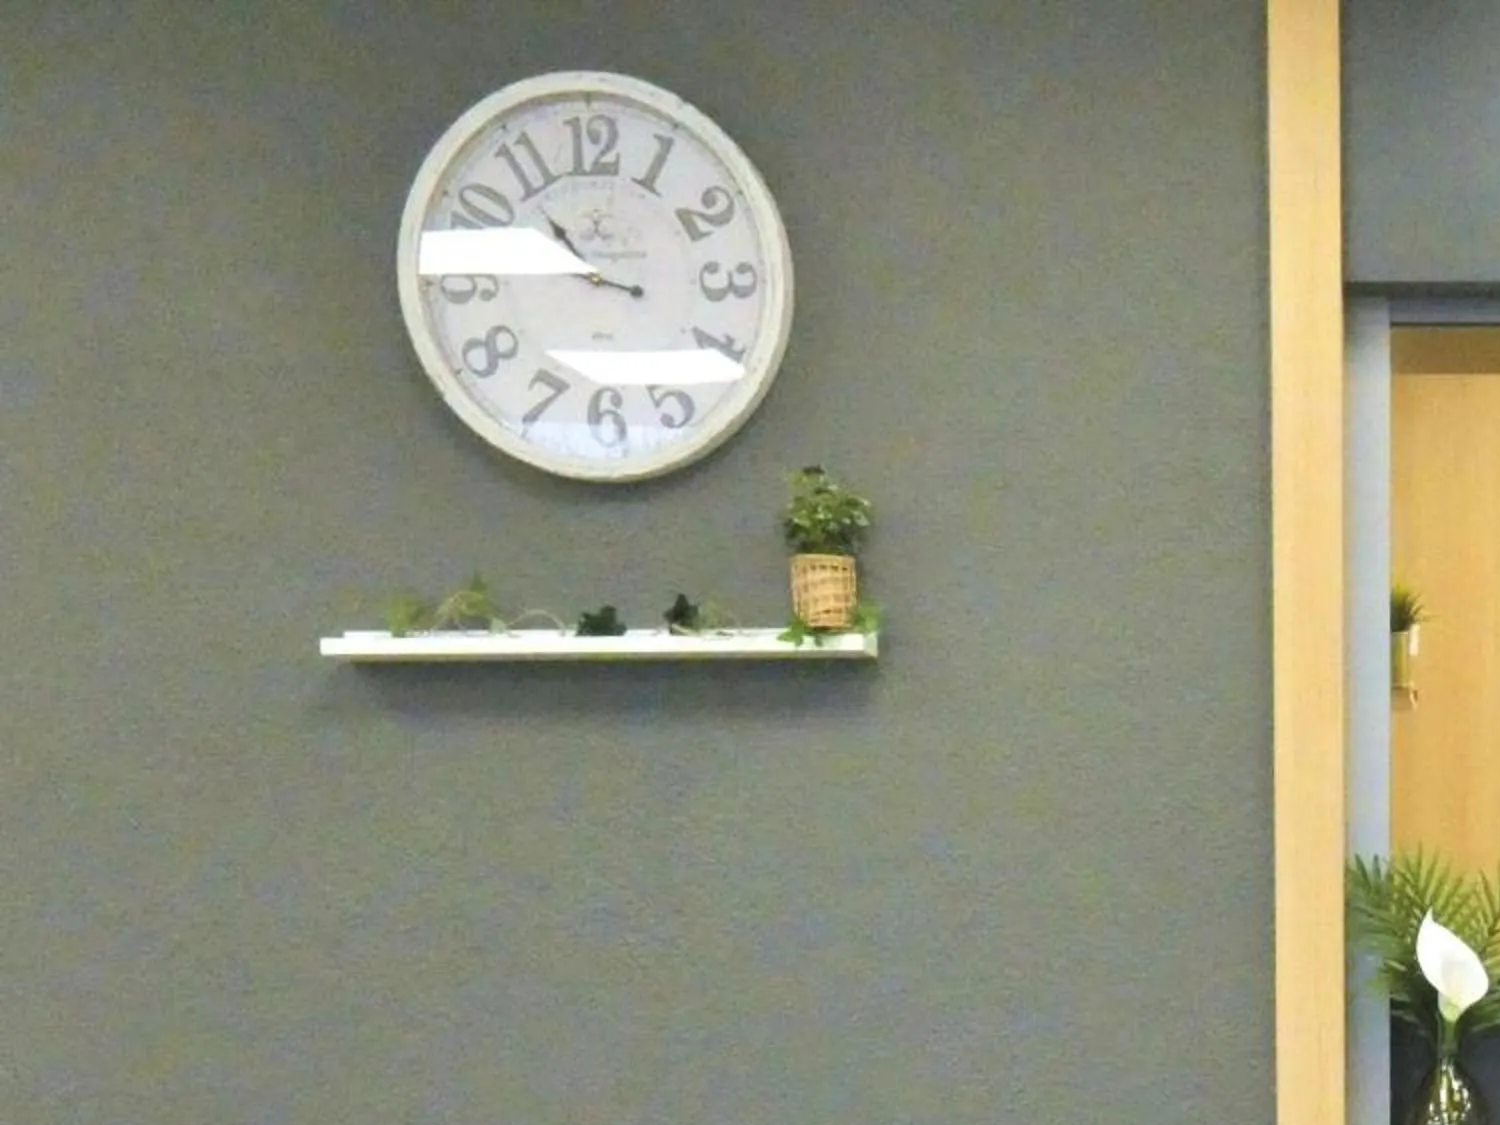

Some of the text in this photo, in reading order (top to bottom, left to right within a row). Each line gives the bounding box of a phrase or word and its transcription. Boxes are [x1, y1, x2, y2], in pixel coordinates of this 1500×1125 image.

[494, 132, 563, 202] 11
[563, 114, 621, 177] 12
[631, 133, 676, 197] 1
[674, 186, 735, 242] 2
[699, 261, 758, 303] 3
[461, 325, 519, 378] 8
[523, 369, 571, 437] 7
[587, 386, 627, 448] 6
[645, 384, 696, 429] 5
